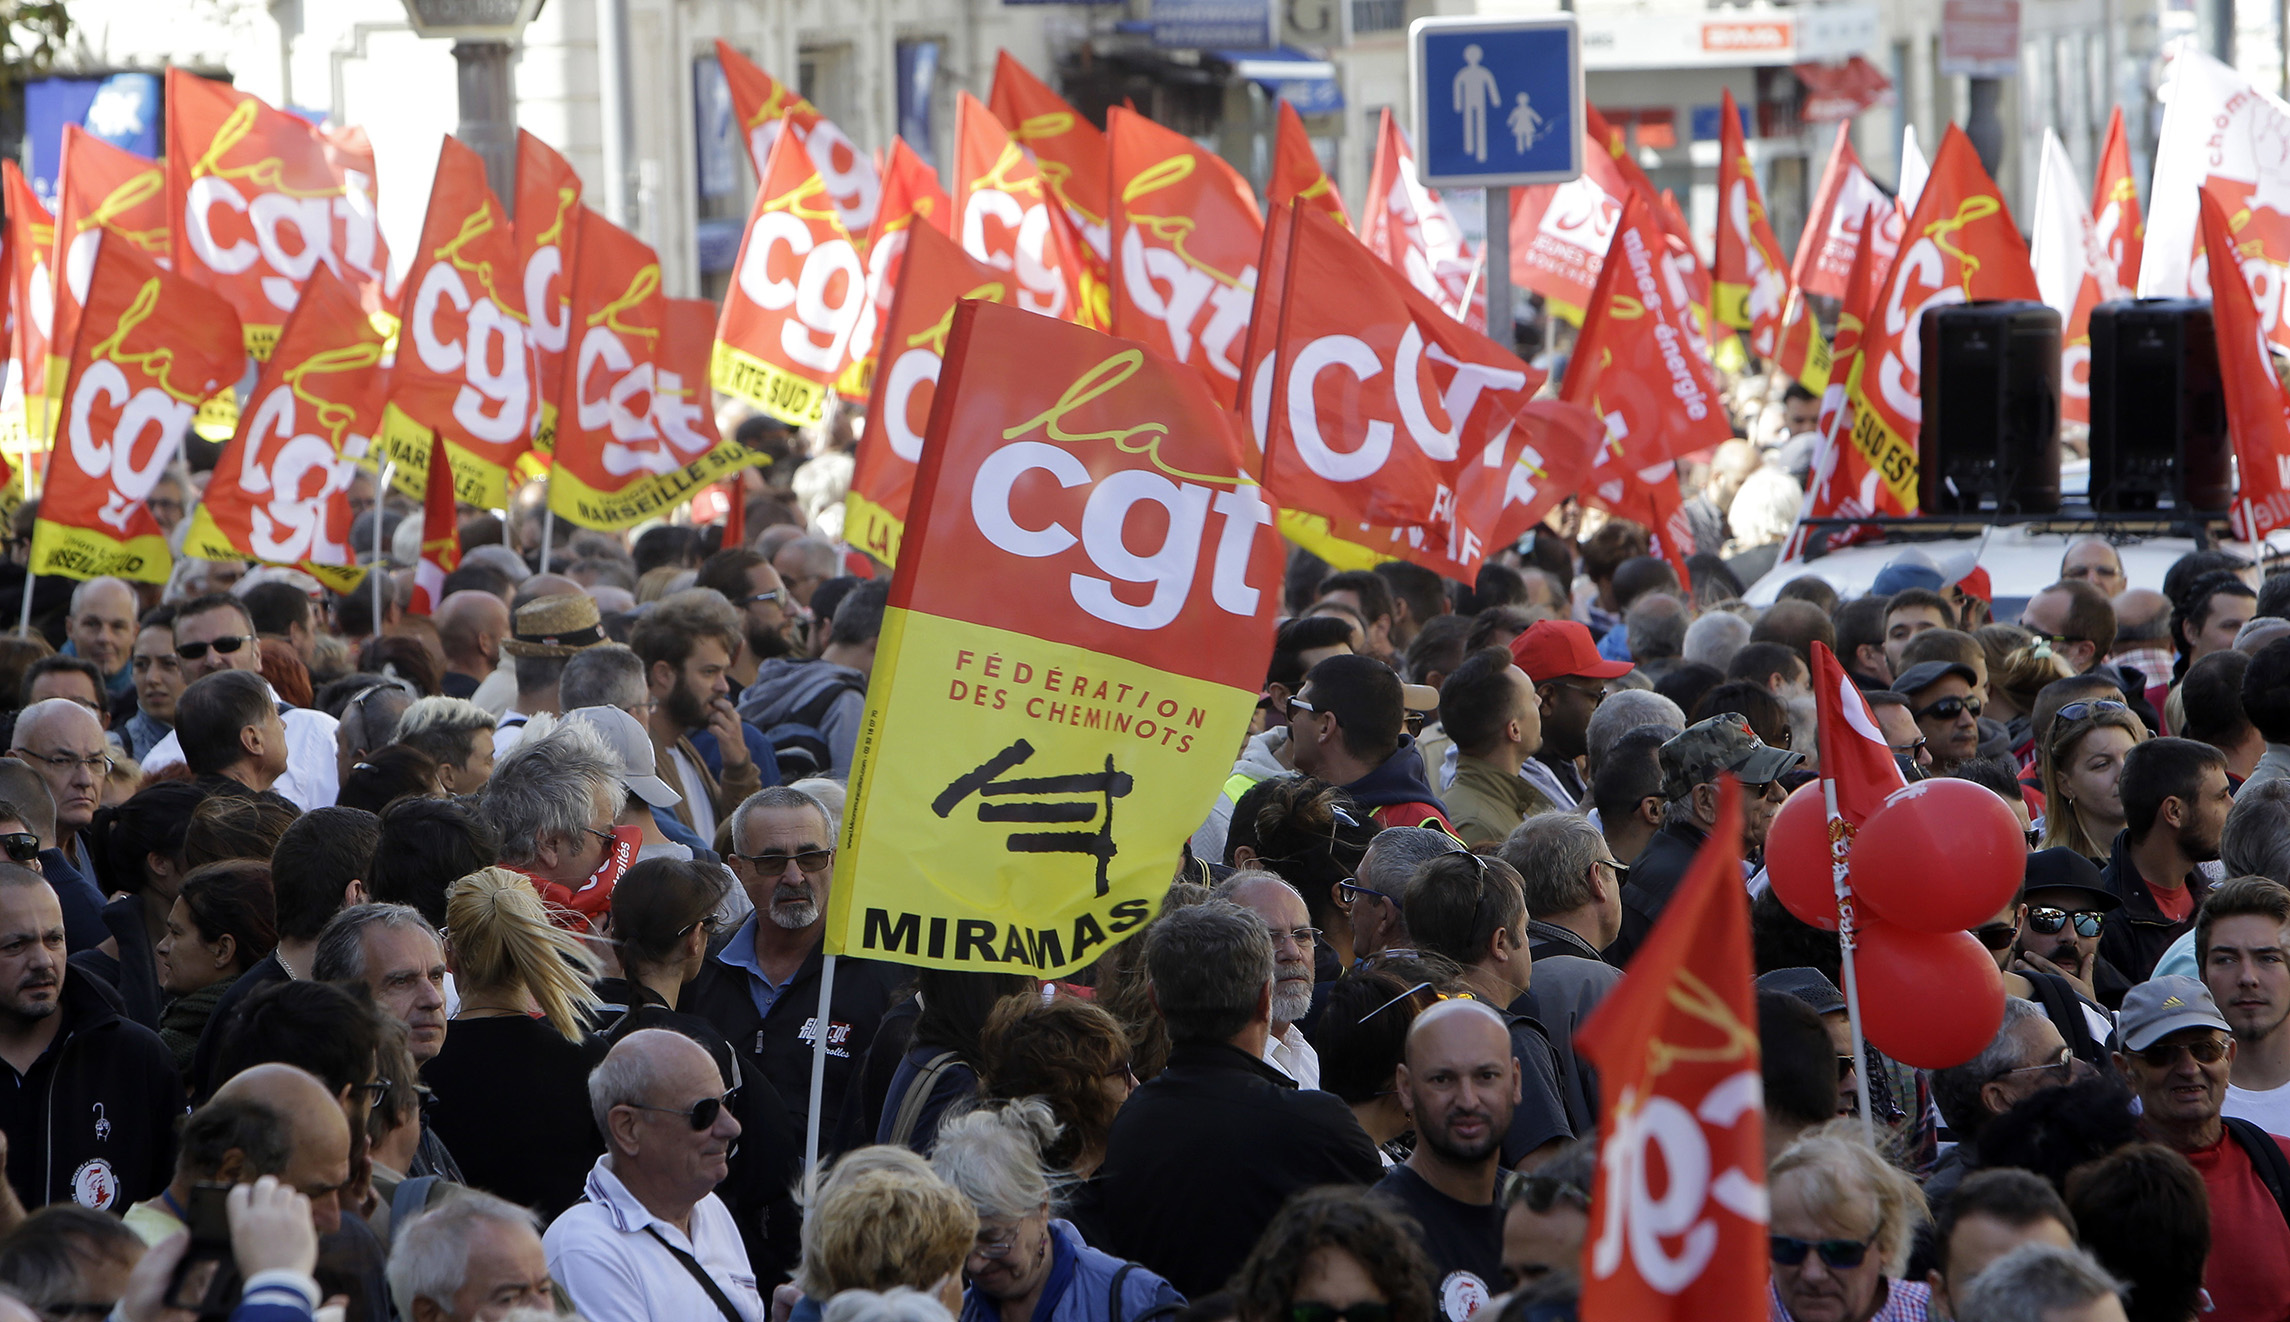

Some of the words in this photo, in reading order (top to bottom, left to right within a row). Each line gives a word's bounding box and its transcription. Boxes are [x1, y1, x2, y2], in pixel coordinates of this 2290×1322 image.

[91, 277, 206, 405] la
[1002, 349, 1263, 488] la
[1857, 412, 1886, 460] SUD
[577, 460, 706, 525] MARSEILLE
[971, 457, 1273, 630] cgt
[949, 679, 1008, 711] DES
[1026, 697, 1195, 753] CHEMINOTS
[955, 649, 1206, 729] FÉDÉRATION
[606, 841, 631, 900] traités
[862, 898, 1150, 970] MIRAMAS
